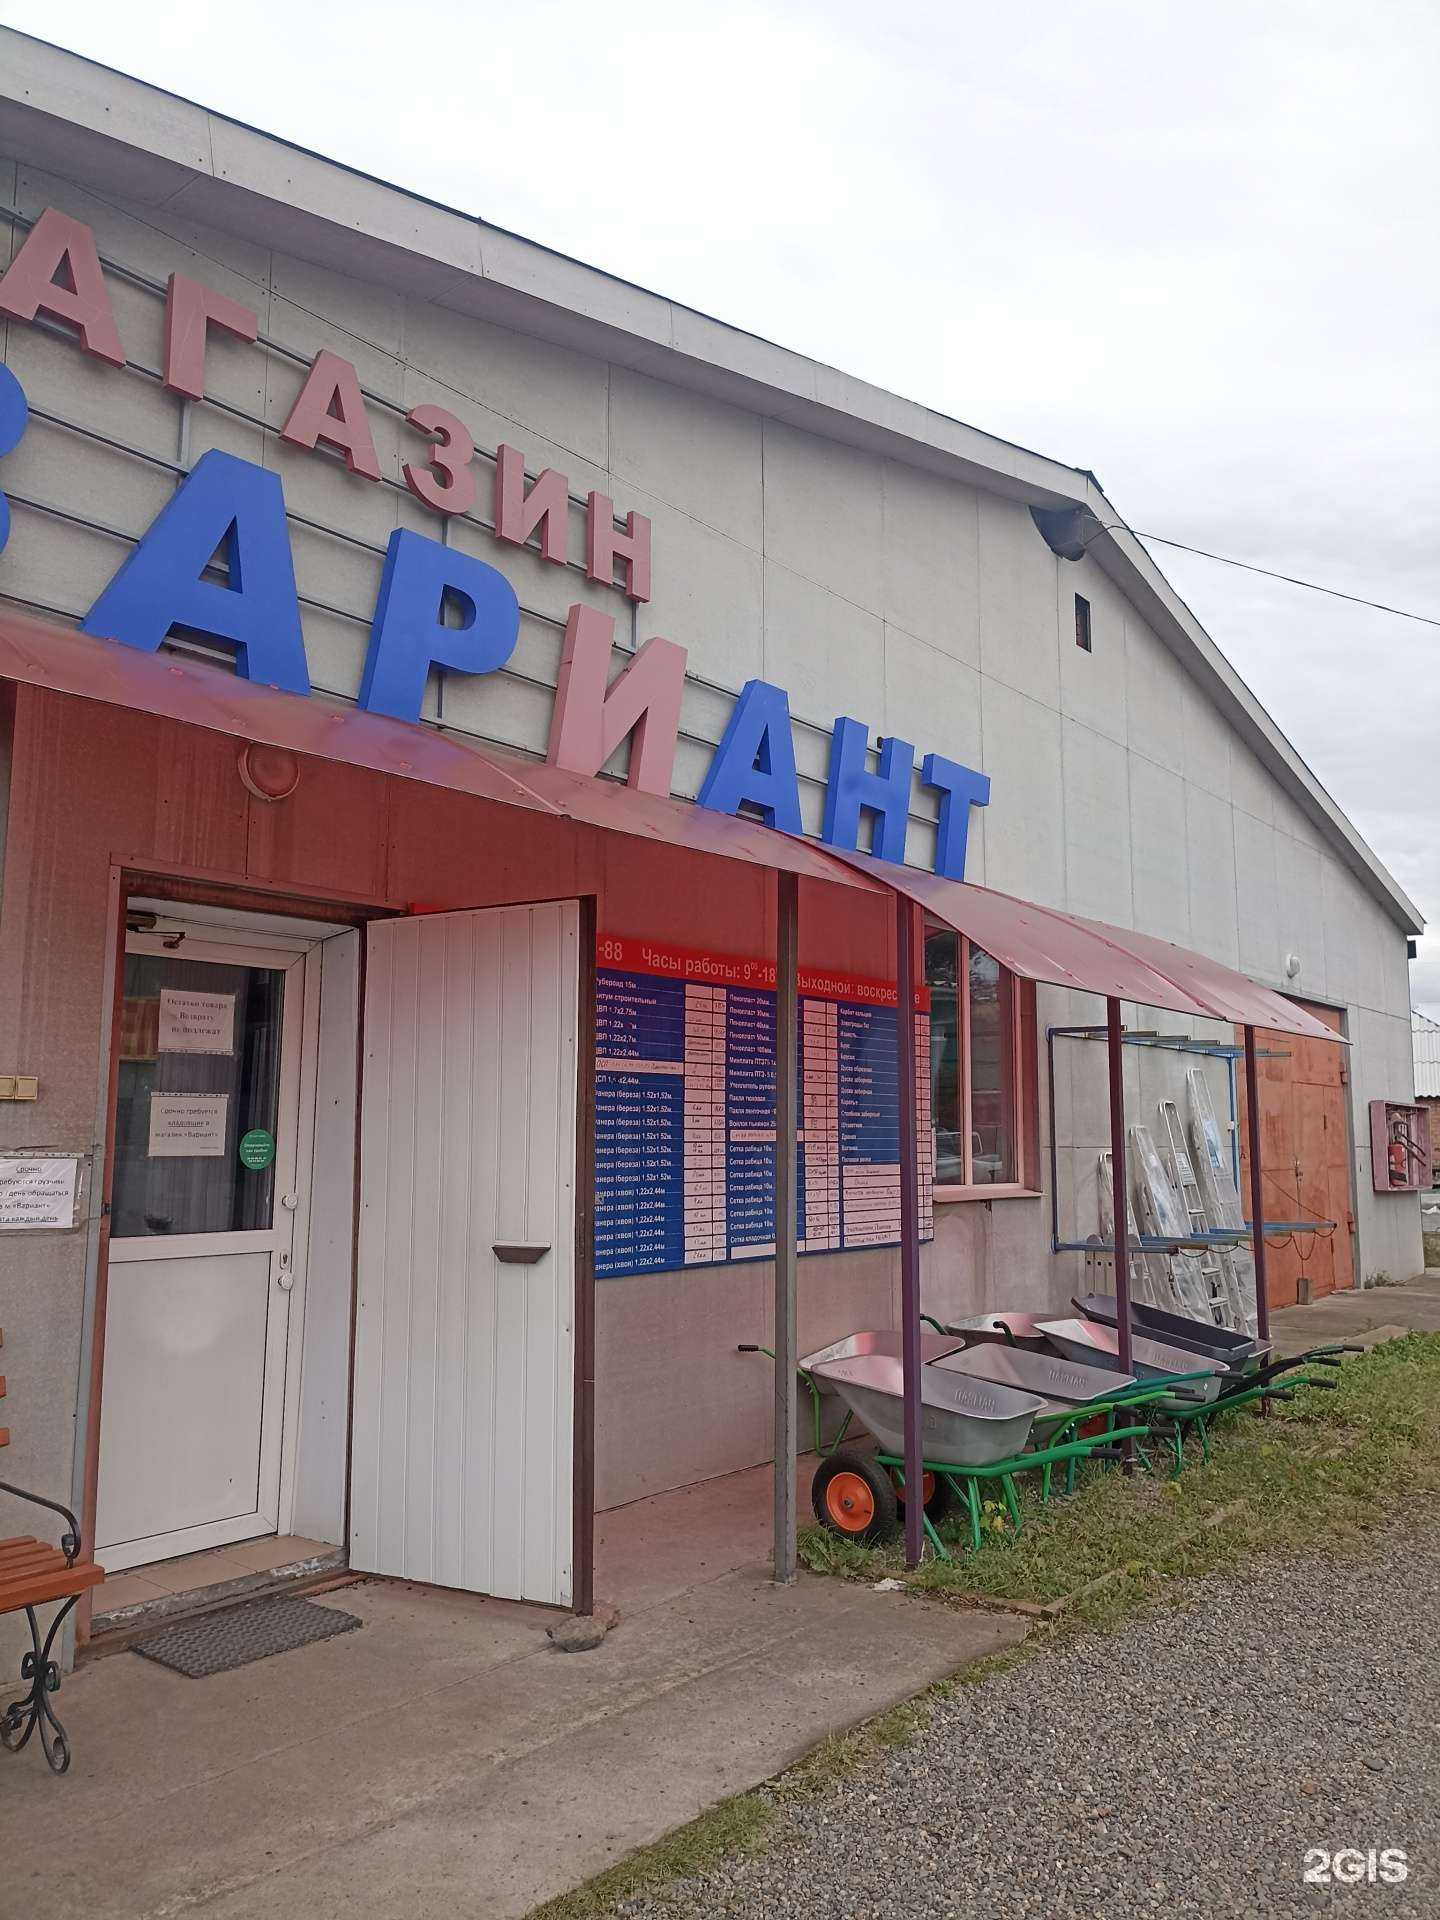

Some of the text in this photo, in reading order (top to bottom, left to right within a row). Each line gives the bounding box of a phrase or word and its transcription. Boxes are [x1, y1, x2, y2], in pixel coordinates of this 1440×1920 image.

[0, 207, 652, 604] АГАЗИН
[641, 948, 681, 971] Часы
[685, 957, 740, 979] работы:
[730, 1158, 744, 1166] Сетка
[595, 1191, 614, 1199] анера
[595, 1204, 614, 1213] анера
[595, 1219, 614, 1228] анера
[731, 1223, 744, 1231] Сетка
[595, 1233, 614, 1242] анера
[595, 1247, 614, 1257] анера
[595, 1261, 614, 1271] анера
